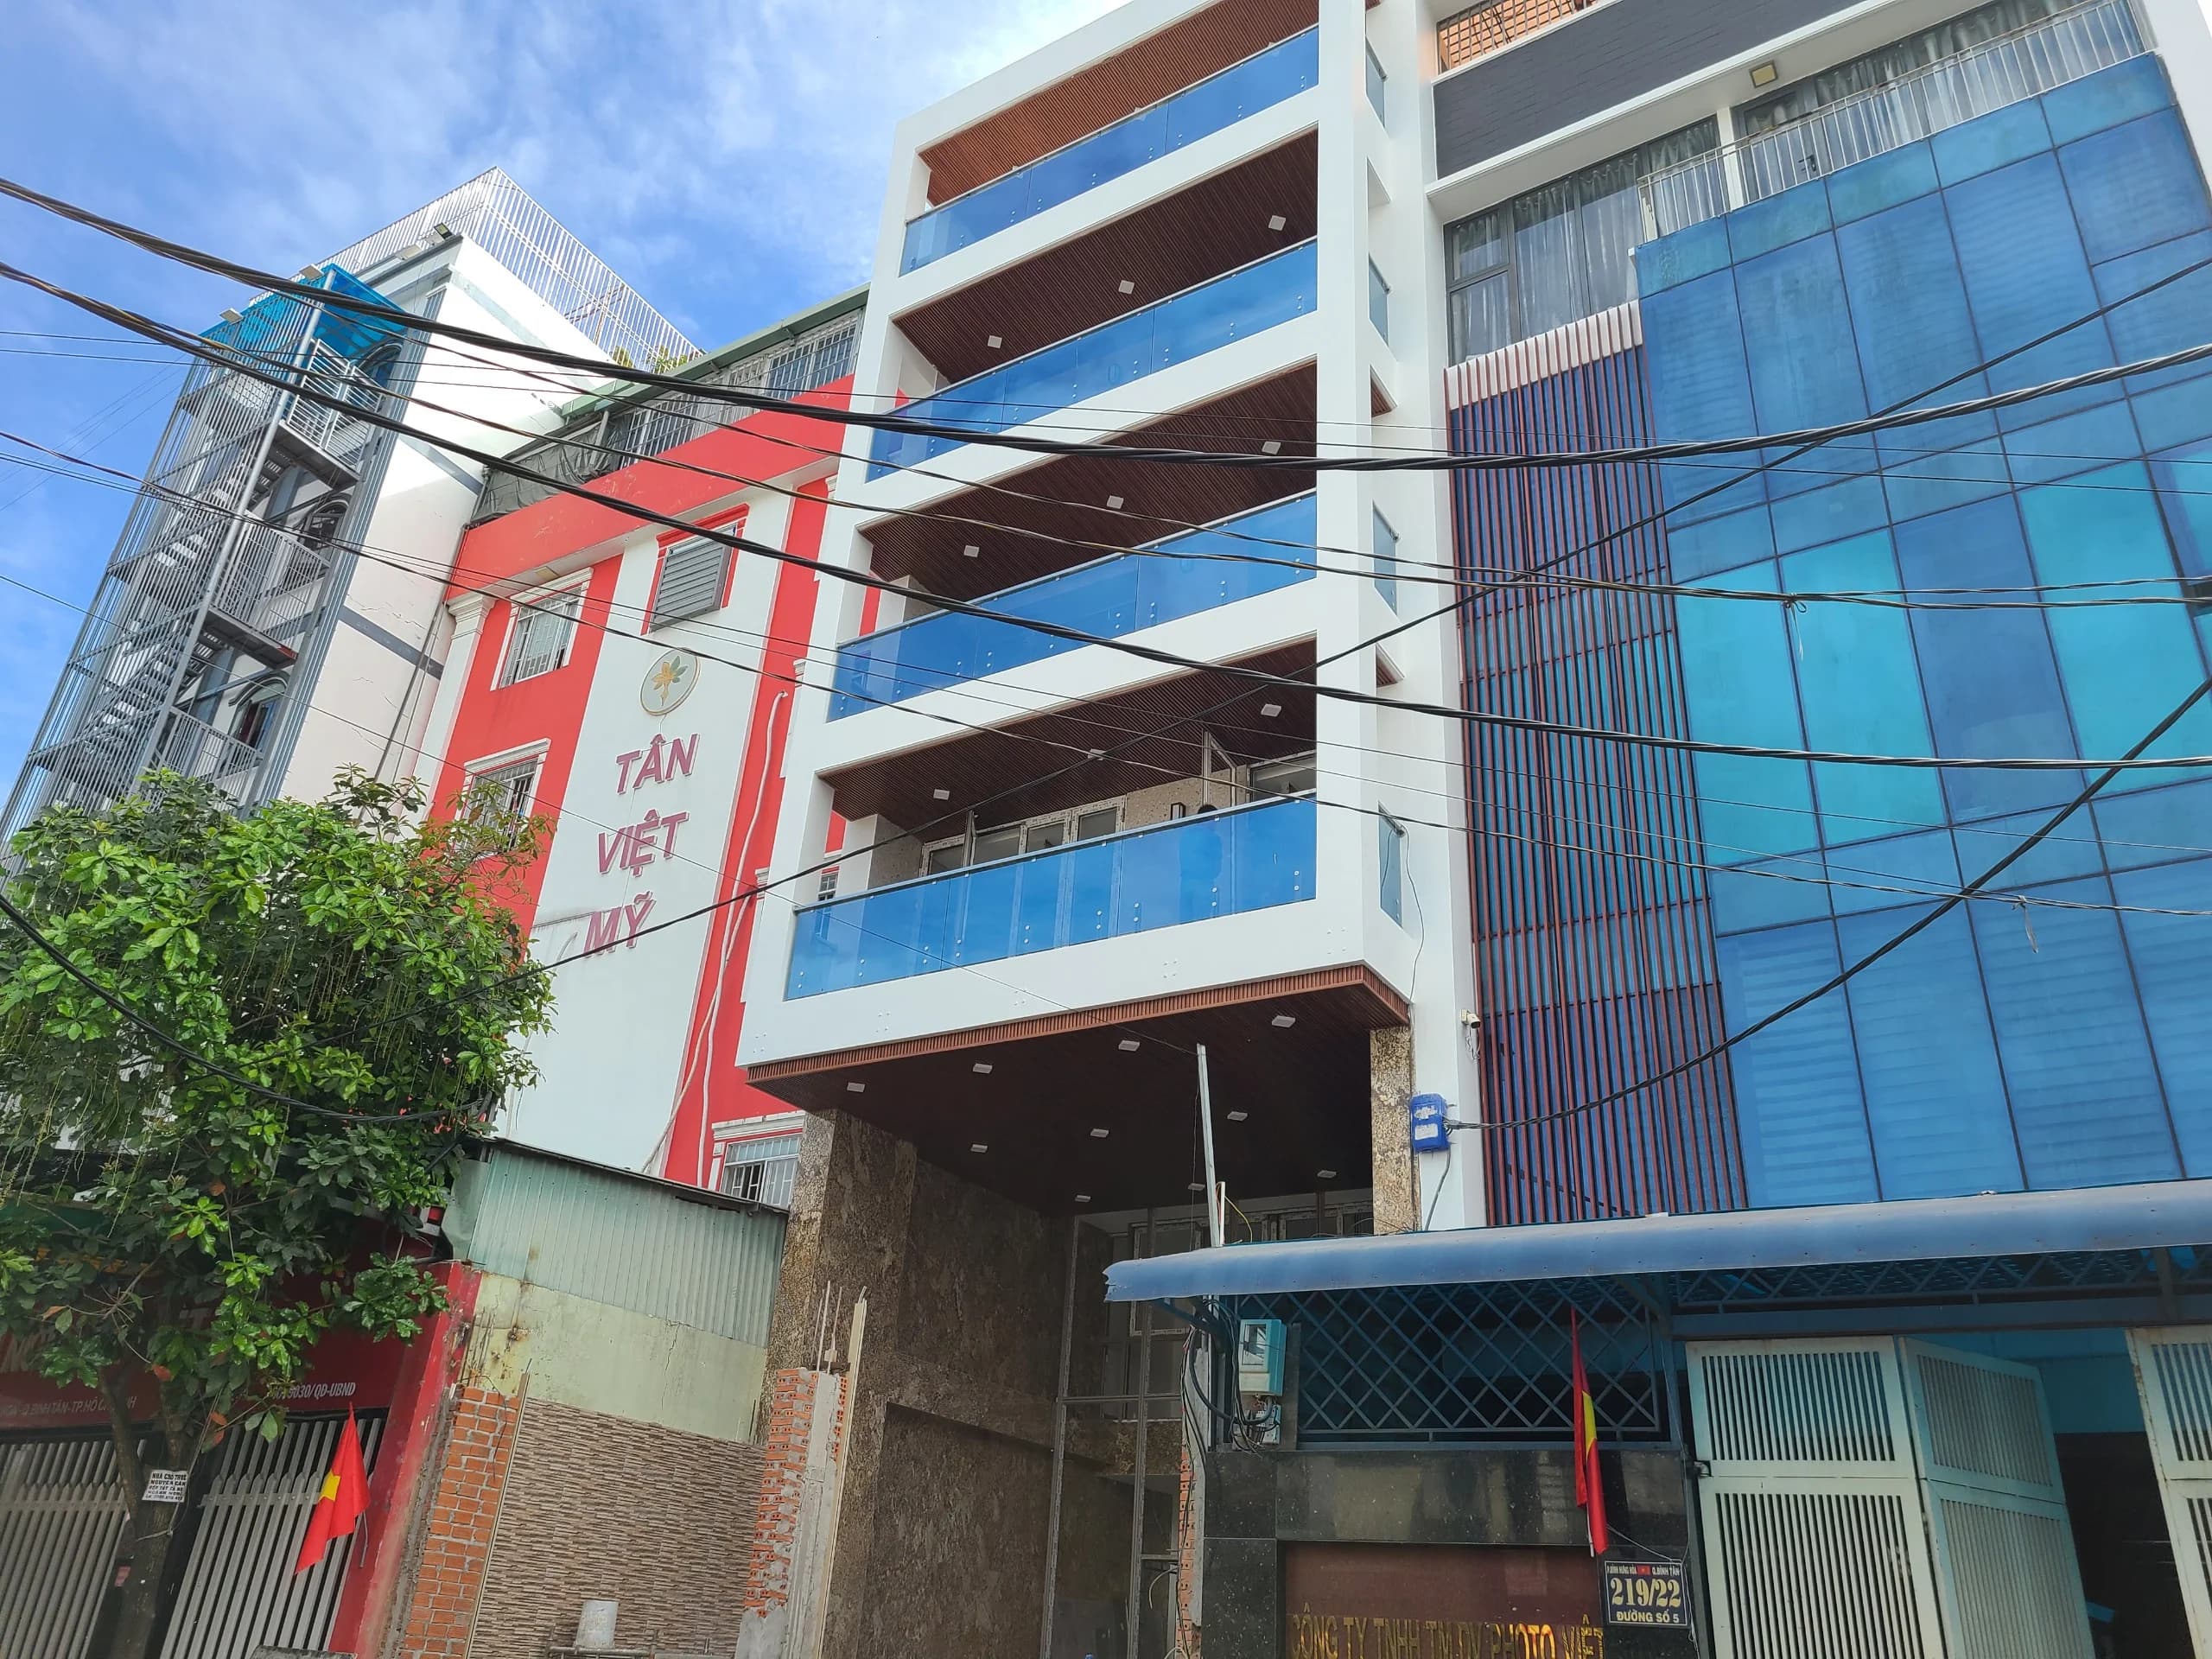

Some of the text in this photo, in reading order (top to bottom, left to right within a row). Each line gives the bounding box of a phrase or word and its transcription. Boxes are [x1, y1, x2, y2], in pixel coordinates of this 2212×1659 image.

[615, 734, 699, 795] TÂN
[597, 809, 690, 877] VIỆT
[583, 891, 657, 957] MỸ
[1610, 1577, 1681, 1607] 219/22
[1617, 1609, 1680, 1623] ĐƯỜNG SỐ 5
[1343, 1617, 1368, 1659] TY
[1490, 1624, 1556, 1659] PHOTO
